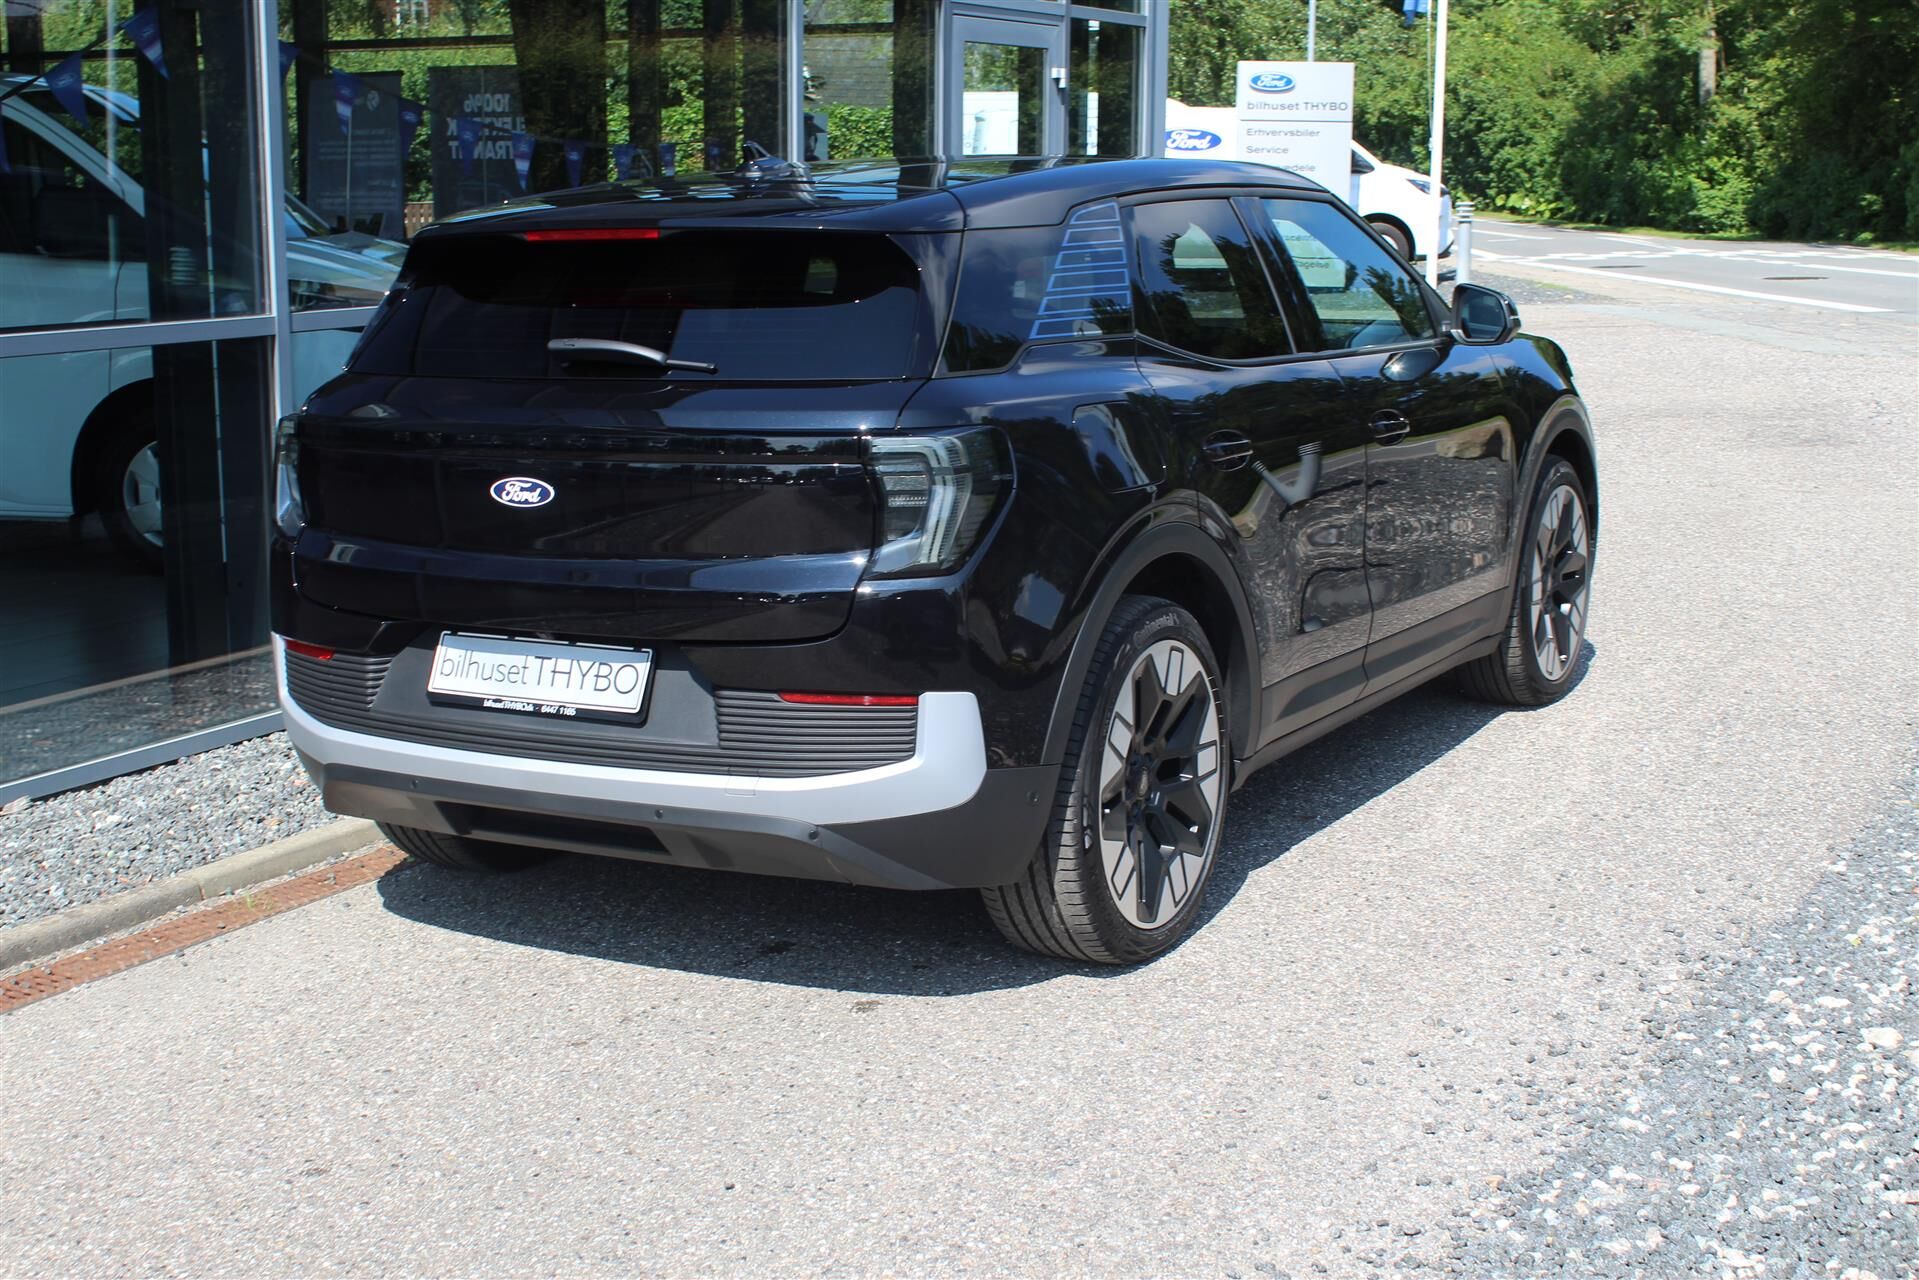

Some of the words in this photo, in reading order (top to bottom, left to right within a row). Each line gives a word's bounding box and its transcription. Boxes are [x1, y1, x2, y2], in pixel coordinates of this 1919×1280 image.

[1257, 74, 1288, 88] Ford
[1246, 101, 1300, 111] bilhuset
[1303, 102, 1349, 112] THYBO
[1166, 129, 1213, 150] Ford
[1246, 128, 1321, 138] Erhvervsbiler
[1246, 145, 1290, 154] Service
[501, 480, 541, 504] Ford
[440, 647, 530, 687] bilhuset
[533, 655, 640, 696] THYBO
